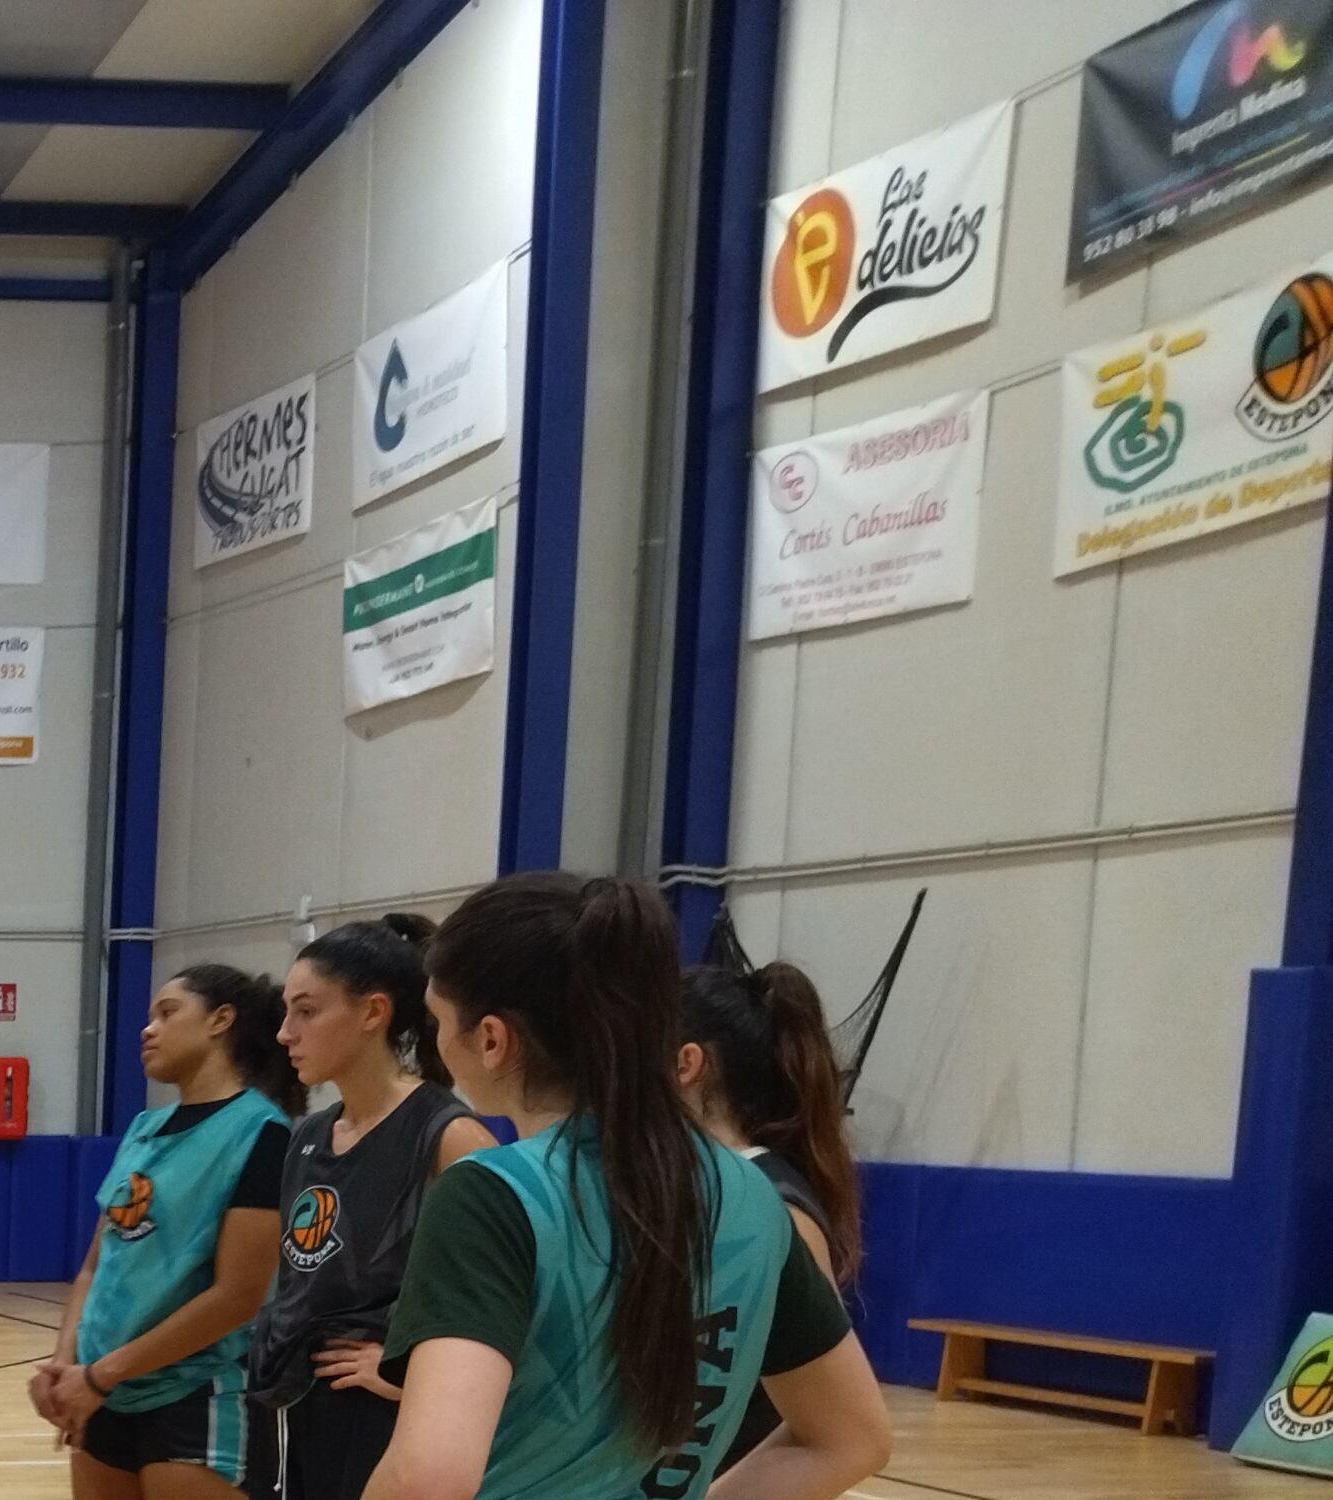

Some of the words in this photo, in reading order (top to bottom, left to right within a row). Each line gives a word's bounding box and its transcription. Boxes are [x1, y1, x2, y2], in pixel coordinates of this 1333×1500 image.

[1243, 378, 1333, 432] ESTEPON
[842, 489, 949, 547] Cabanillas
[1268, 1396, 1333, 1436] ESTEPON
